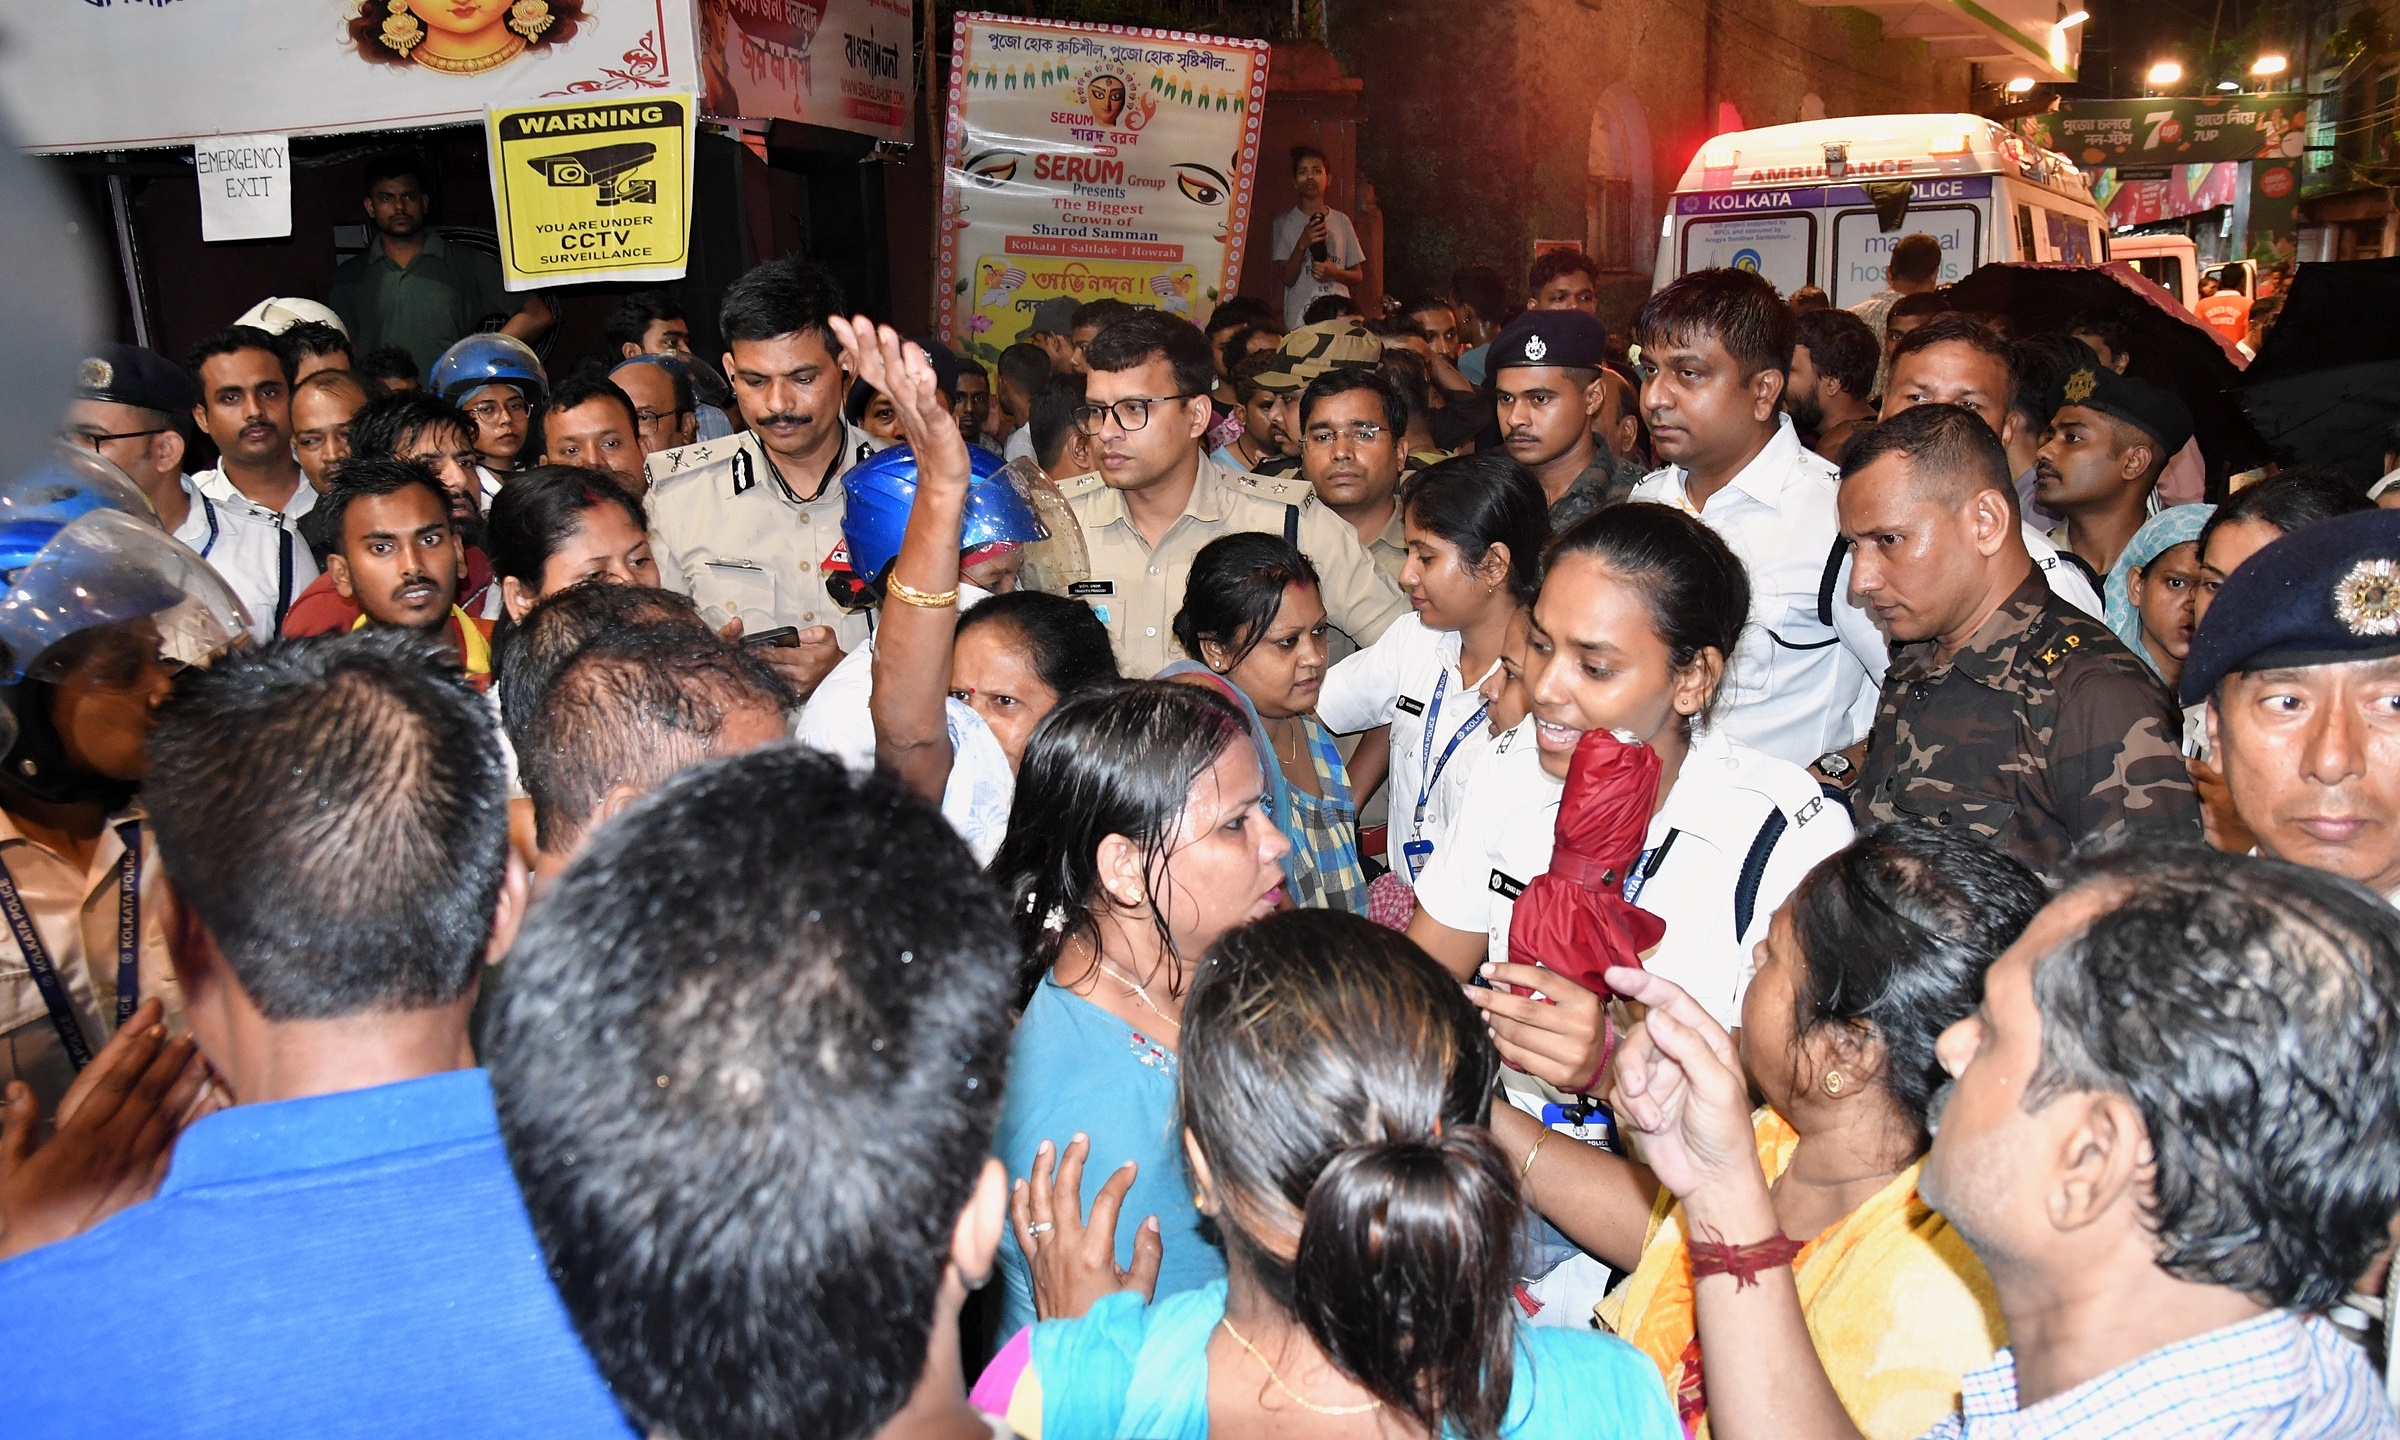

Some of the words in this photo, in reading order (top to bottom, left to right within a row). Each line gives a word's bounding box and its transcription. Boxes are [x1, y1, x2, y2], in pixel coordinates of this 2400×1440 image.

[988, 33, 1021, 52] পুজো
[1025, 36, 1053, 52] হোক
[1110, 44, 1142, 63] পুজো
[1145, 49, 1174, 65] হোক
[518, 106, 663, 134] WARNING
[1050, 112, 1094, 126] SERUM
[1071, 128, 1105, 142] শারদ
[1110, 131, 1139, 145] বরন
[2194, 130, 2219, 142] 7UP
[198, 147, 284, 173] EMERGENCY
[1033, 153, 1123, 185] SERUM
[1128, 174, 1166, 191] Group
[1749, 159, 1913, 184] AMBULANCE
[226, 176, 272, 198] EXIT
[1073, 183, 1126, 198] Presents
[1708, 192, 1792, 211] KOLKATA
[1909, 180, 1963, 199] OLICE
[1052, 198, 1081, 210] The
[1086, 200, 1144, 215] Biggest
[536, 223, 564, 233] YOU
[568, 220, 597, 231] ARE
[600, 216, 653, 228] UNDER
[1062, 213, 1112, 226] Crown
[1116, 216, 1134, 227] of
[561, 230, 630, 250] CCTV
[1032, 224, 1087, 237] Sharod
[1092, 227, 1158, 241] Samman
[540, 247, 652, 264] SURVEILLANCE
[1012, 240, 1056, 251] Kolkata
[1071, 244, 1117, 255] Saltlake
[1132, 246, 1176, 258] Howrah
[1032, 262, 1134, 295] অভিনন্দন
[1426, 716, 1436, 743] POLICE
[1464, 706, 1488, 732] KOLKAT
[120, 894, 137, 949] KOLKATA
[17, 921, 50, 974] KOLKATA
